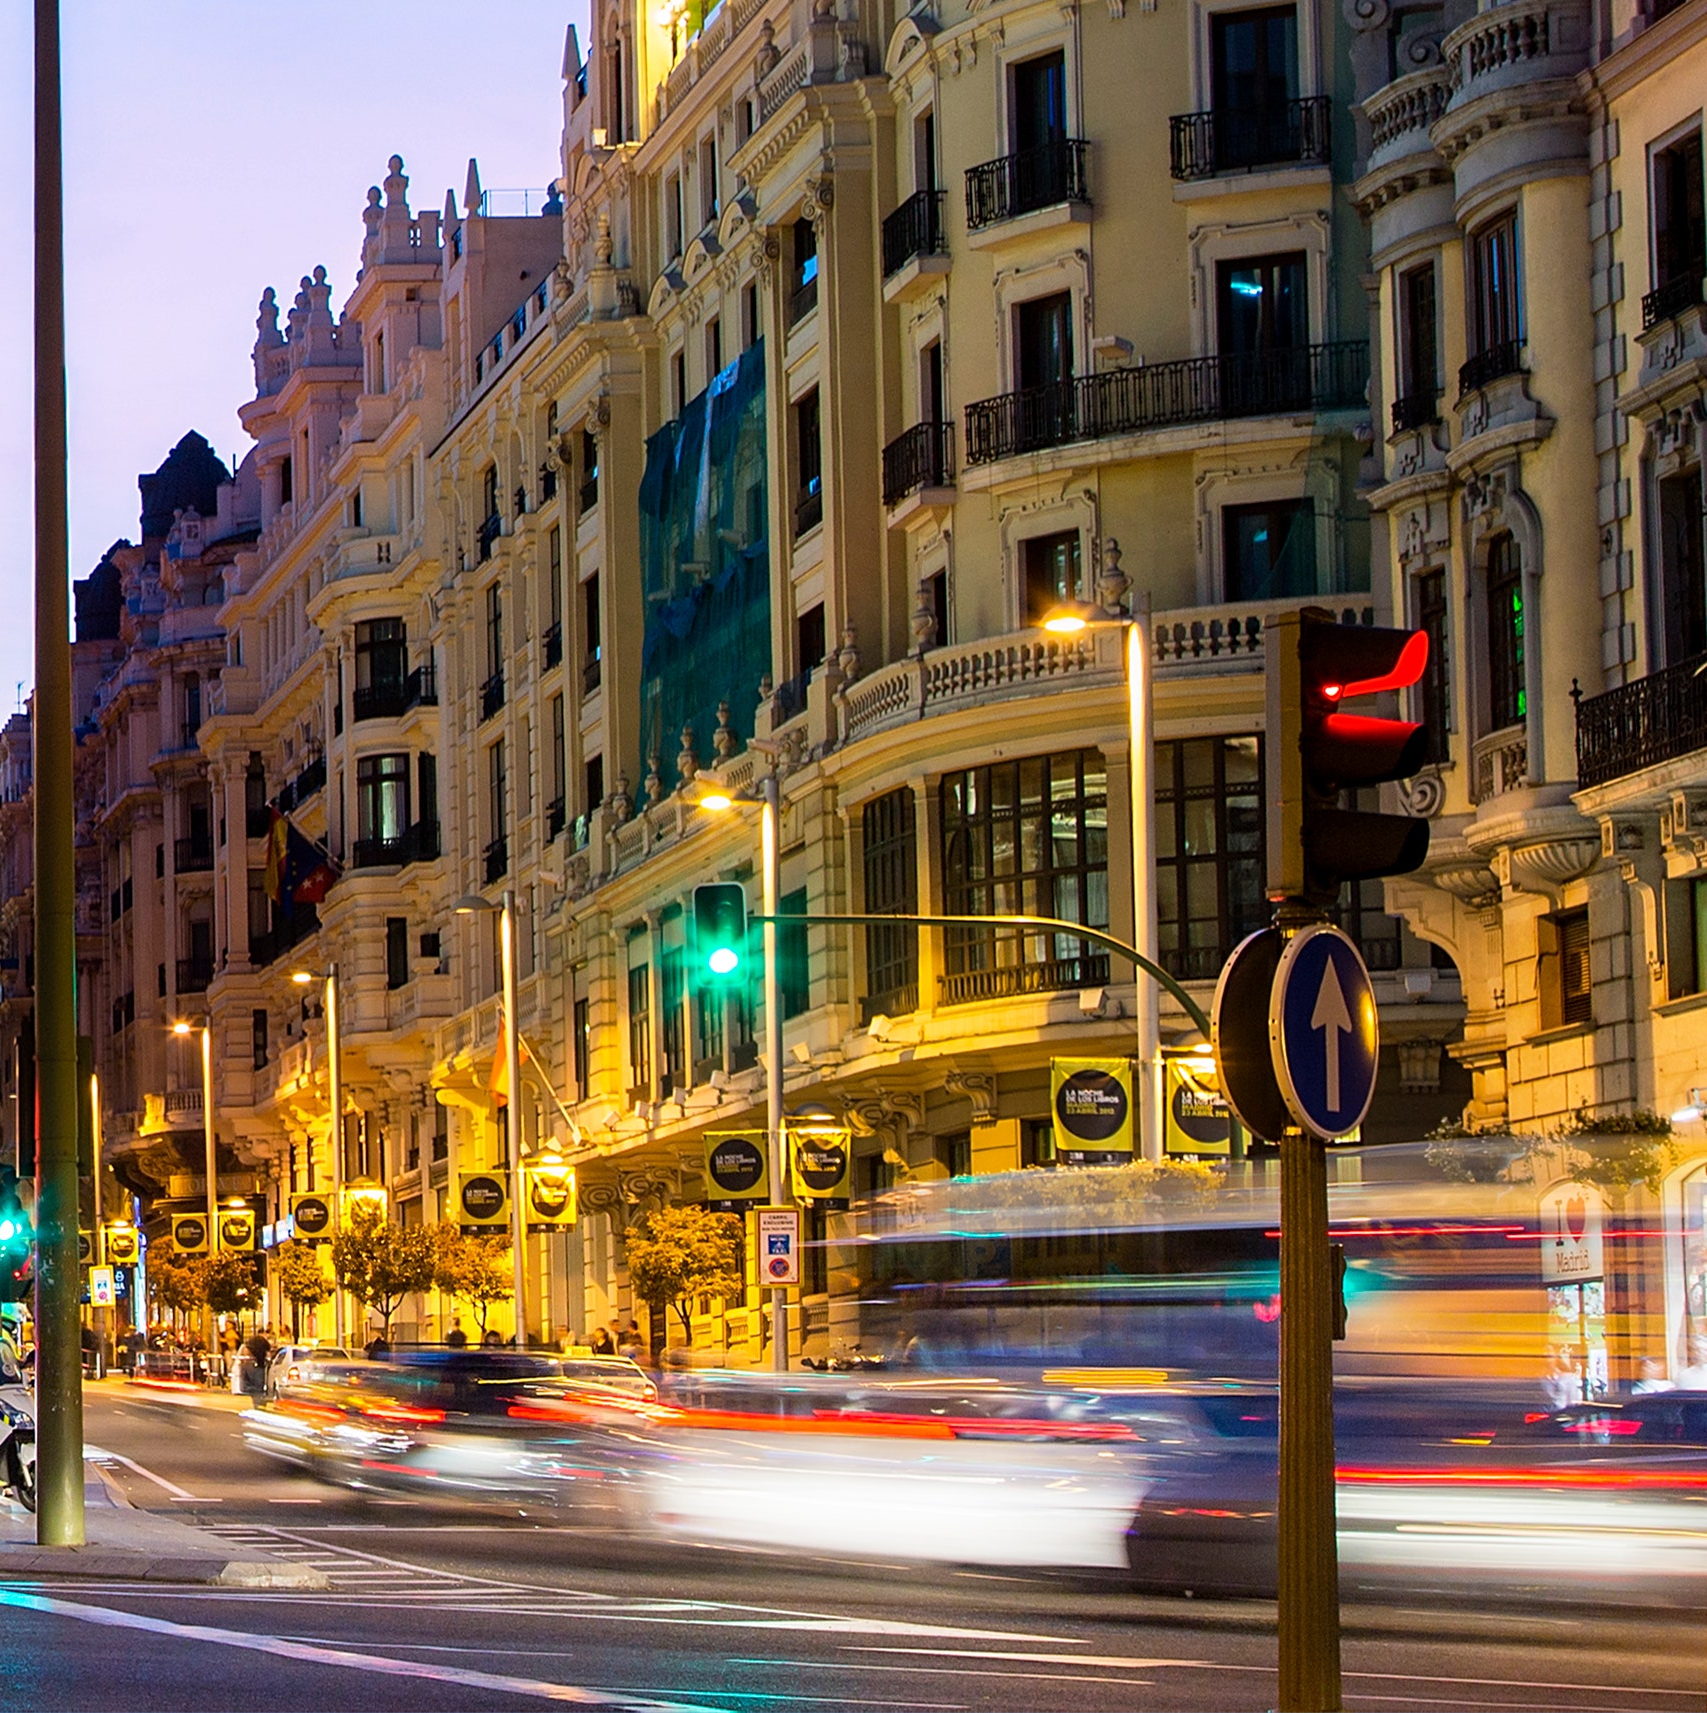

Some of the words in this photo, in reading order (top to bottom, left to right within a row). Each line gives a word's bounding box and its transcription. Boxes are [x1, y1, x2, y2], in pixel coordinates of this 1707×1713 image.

[1077, 1089, 1104, 1097] NOCHE
[1093, 1095, 1119, 1103] LIBROS
[1182, 1097, 1192, 1105] DE
[1554, 1199, 1564, 1247] I
[1556, 1249, 1590, 1274] Madrid
